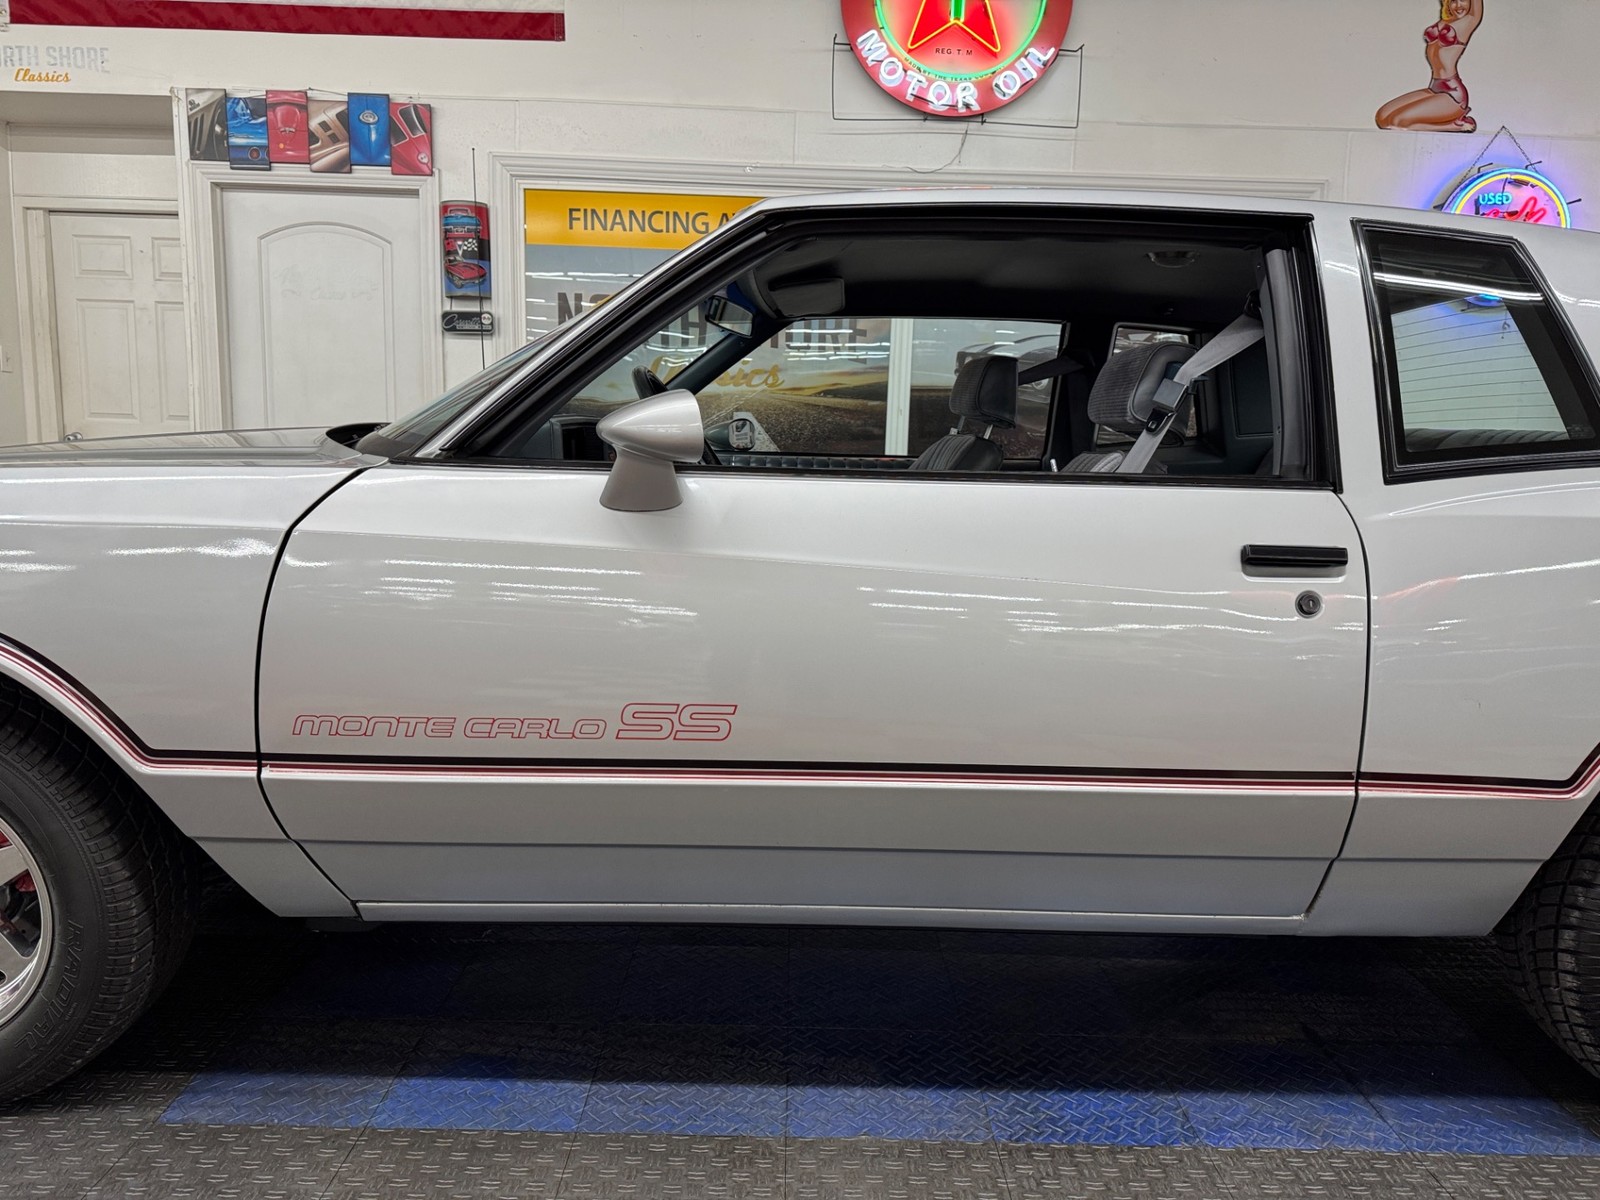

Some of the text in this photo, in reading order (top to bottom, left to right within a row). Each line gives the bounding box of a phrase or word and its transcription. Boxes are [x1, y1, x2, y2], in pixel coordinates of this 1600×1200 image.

[0, 45, 110, 74] RTH SHORE
[857, 29, 1055, 113] MOTOR OIL
[14, 67, 71, 83] Classics
[1479, 192, 1513, 205] USED
[568, 207, 709, 235] FINANCING
[292, 703, 738, 741] MONTE CARLO SS
[14, 920, 84, 1050] RADIAL
